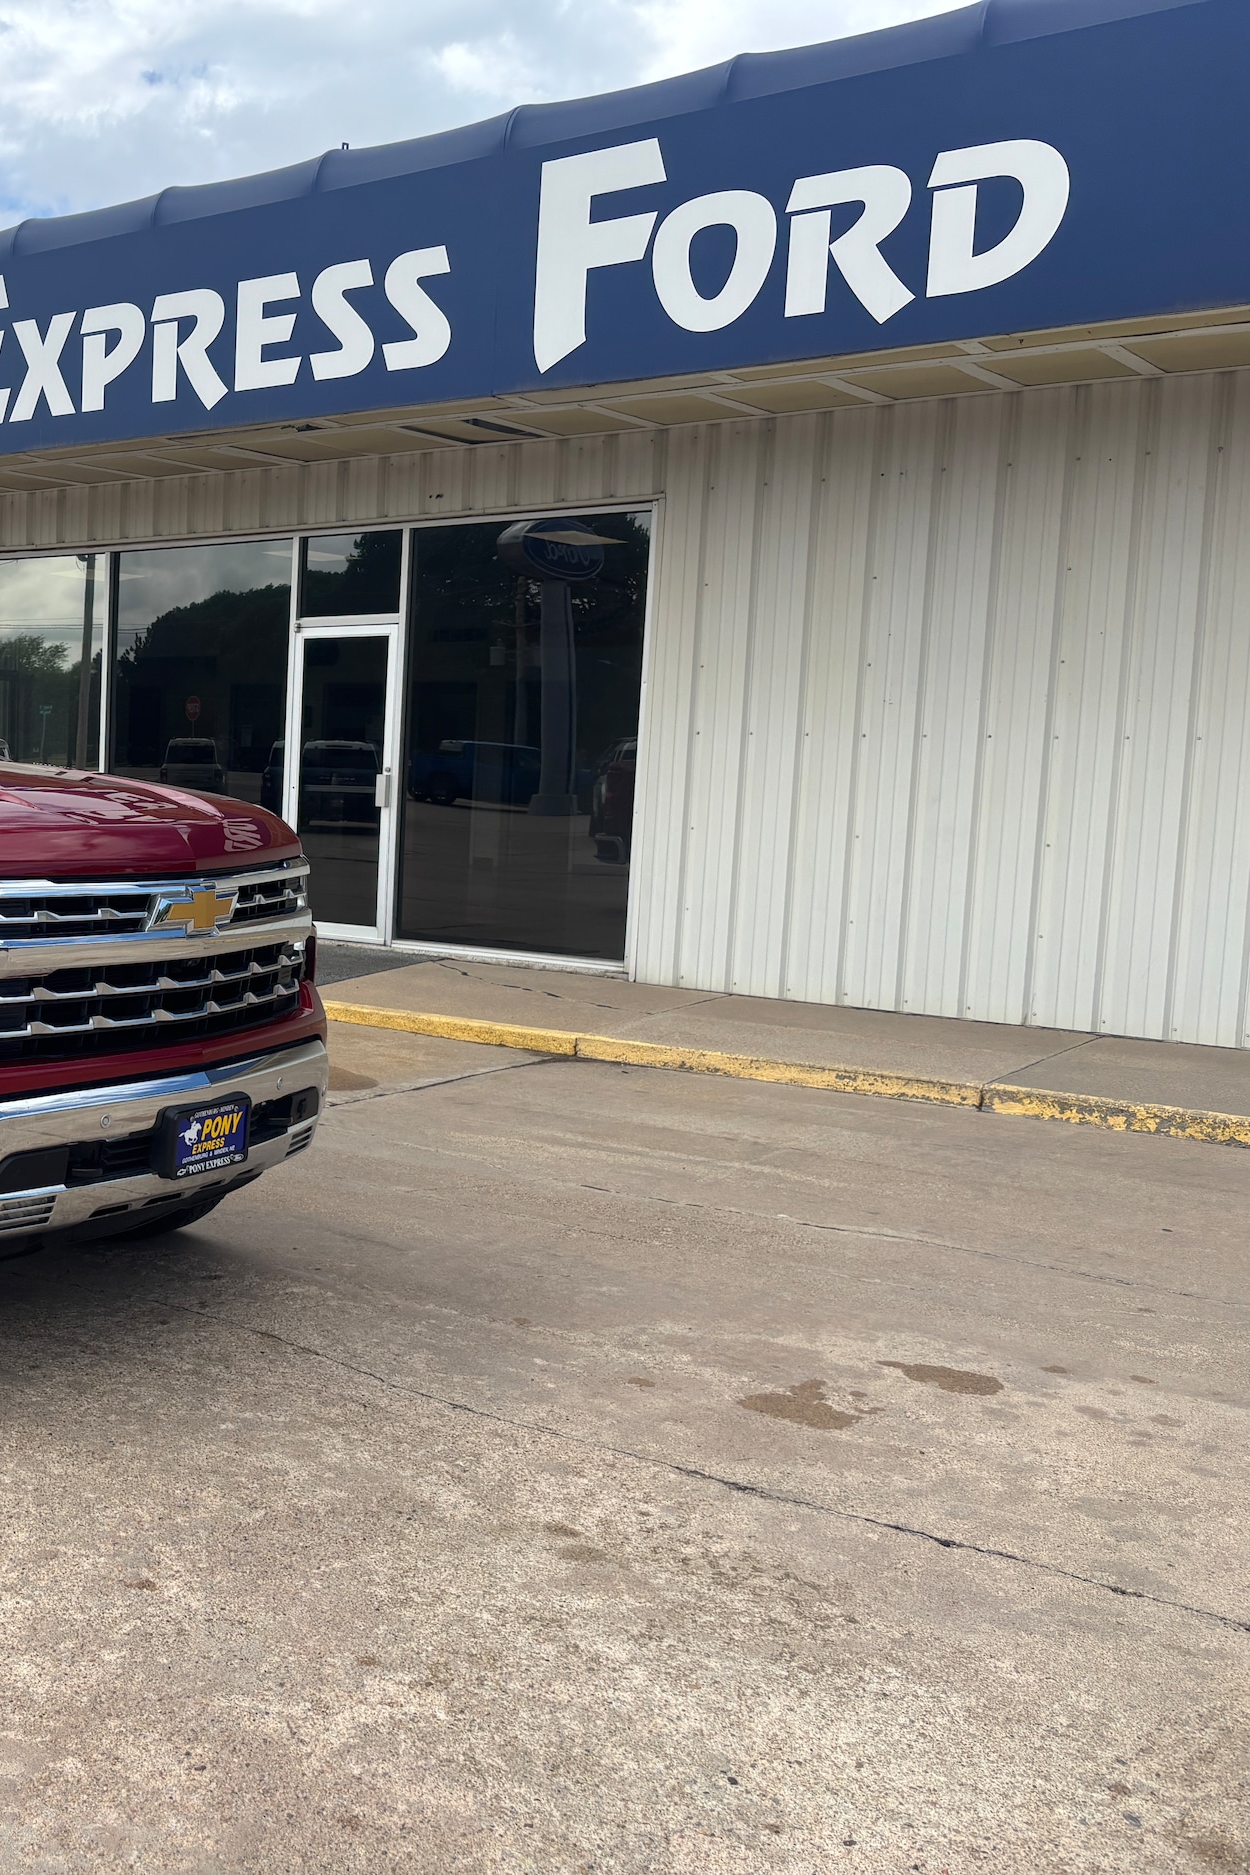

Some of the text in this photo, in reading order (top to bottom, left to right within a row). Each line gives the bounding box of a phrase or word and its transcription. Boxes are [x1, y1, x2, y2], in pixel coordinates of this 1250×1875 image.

[533, 138, 1069, 374] FORD
[201, 1111, 243, 1141] PONY
[192, 1137, 225, 1154] EXPRESS
[189, 1162, 205, 1173] PONY
[206, 1156, 230, 1169] EXPRESS
